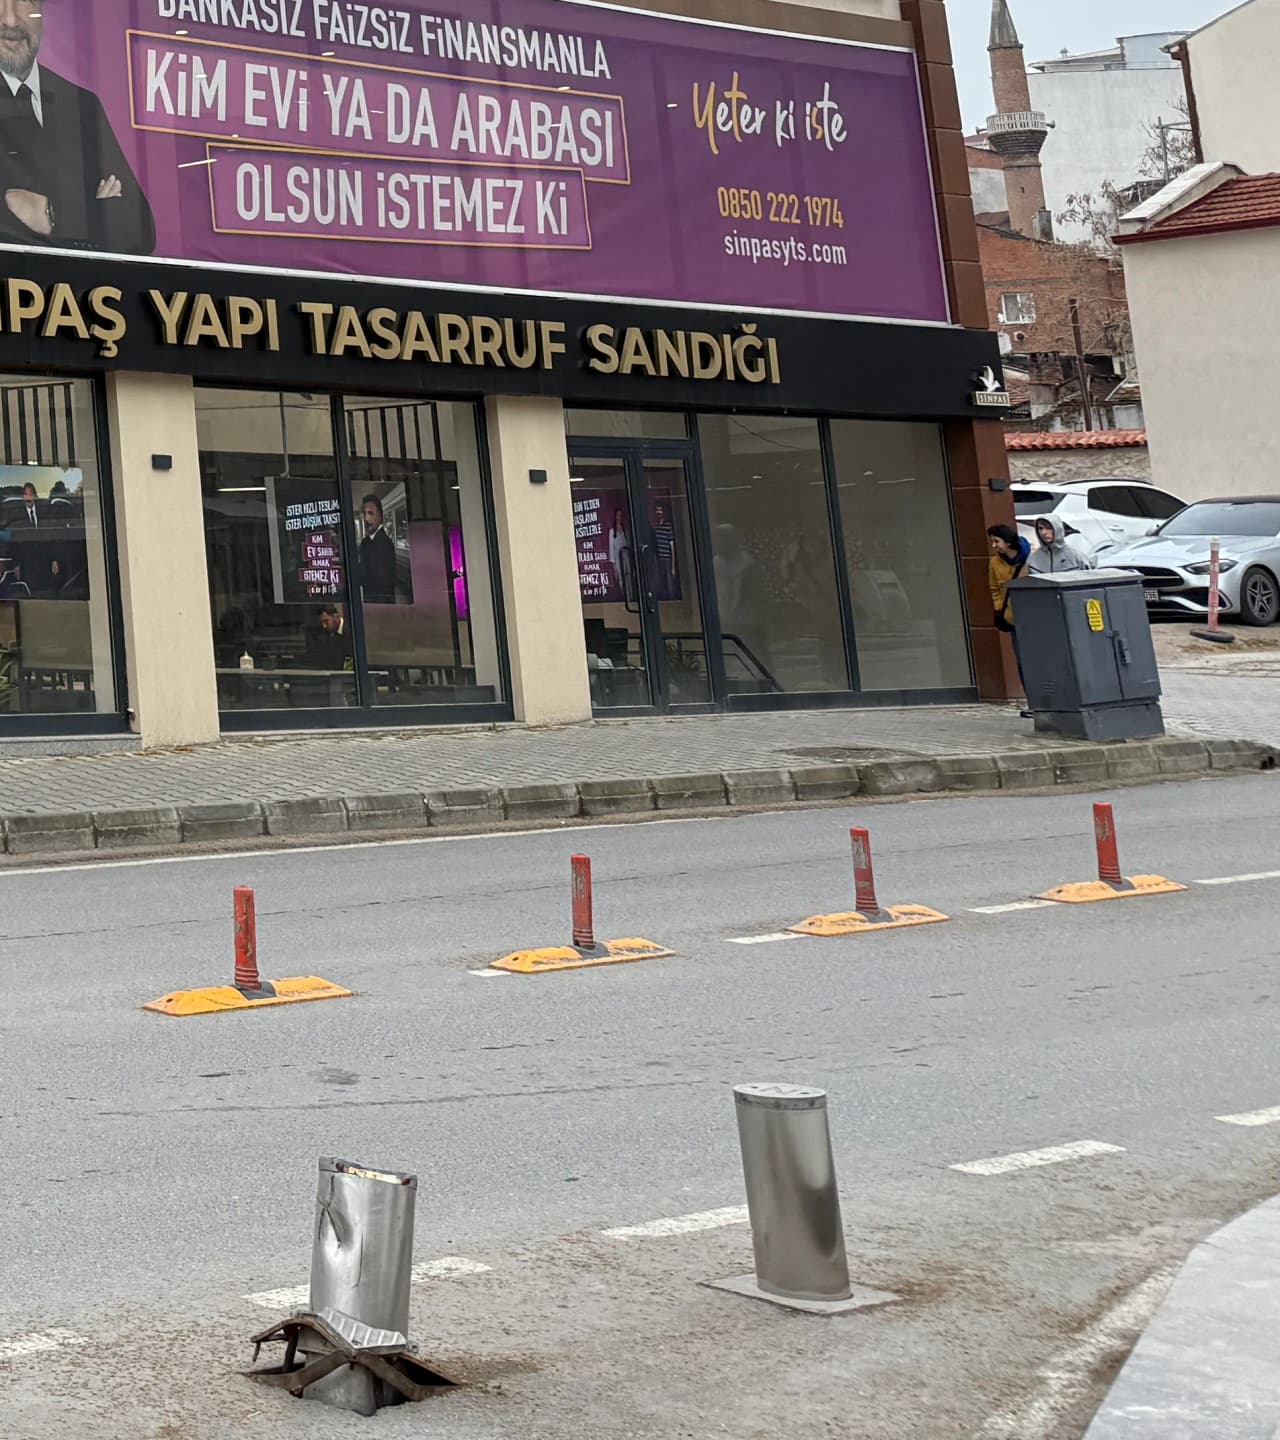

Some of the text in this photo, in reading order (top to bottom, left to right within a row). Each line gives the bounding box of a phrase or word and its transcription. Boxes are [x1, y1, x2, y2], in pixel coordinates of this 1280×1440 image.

[322, 73, 374, 140] YA
[387, 83, 440, 149] DA
[450, 92, 614, 168] ARABASI
[693, 71, 766, 155] Yeter
[805, 81, 848, 152] iste
[236, 162, 364, 226] OLSUN
[717, 186, 844, 228] 0850 222 1974
[724, 229, 848, 266] sinpasyts.com
[148, 288, 281, 352] YAPI
[301, 299, 567, 370] TASARRUF
[587, 322, 780, 385] SANDIĞI
